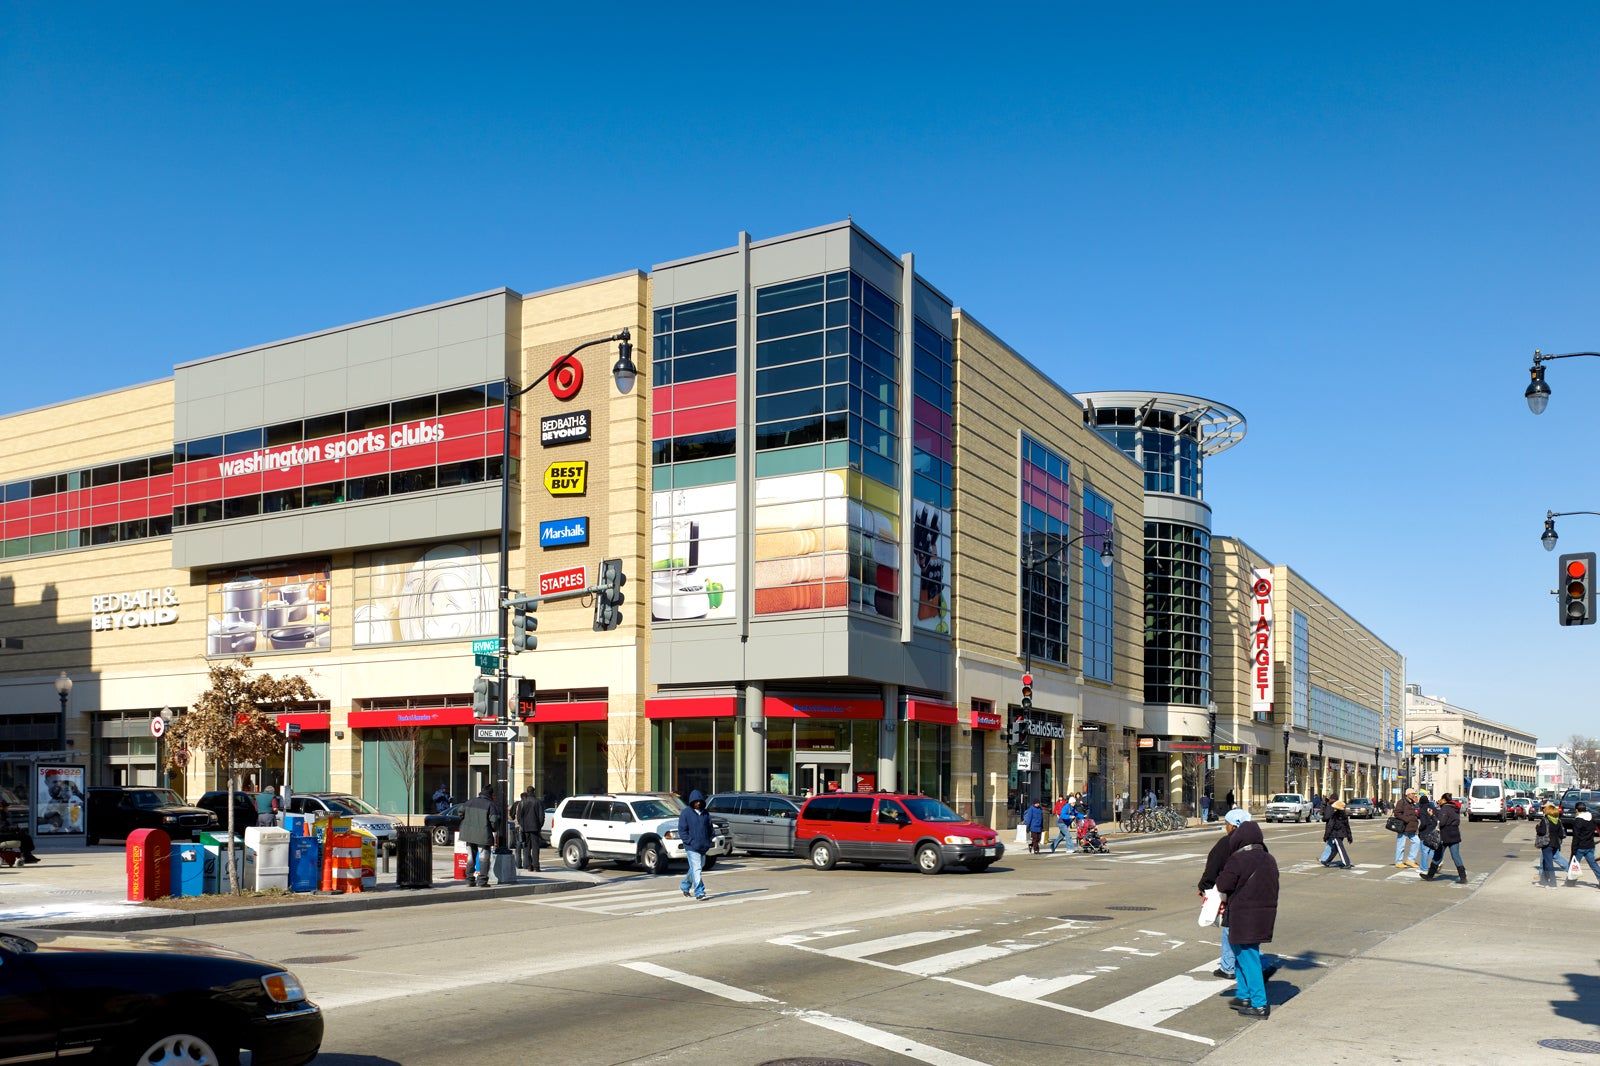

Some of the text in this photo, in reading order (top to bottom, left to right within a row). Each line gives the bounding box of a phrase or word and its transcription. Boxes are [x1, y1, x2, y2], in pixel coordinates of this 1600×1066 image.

[542, 414, 587, 432] BED BATH &
[542, 426, 587, 441] BEYOND
[219, 421, 445, 477] washington sports clubs
[551, 467, 583, 478] BEST
[552, 479, 579, 489] BUY
[542, 524, 585, 540] Marshalls
[541, 573, 583, 591] STAPLES
[161, 586, 178, 606] &
[91, 609, 178, 631] BEYOND
[473, 640, 495, 652] IRVING
[1256, 599, 1269, 700] TARGET
[480, 656, 488, 666] 14
[520, 700, 533, 713] 34
[1028, 720, 1065, 738] RadioShack
